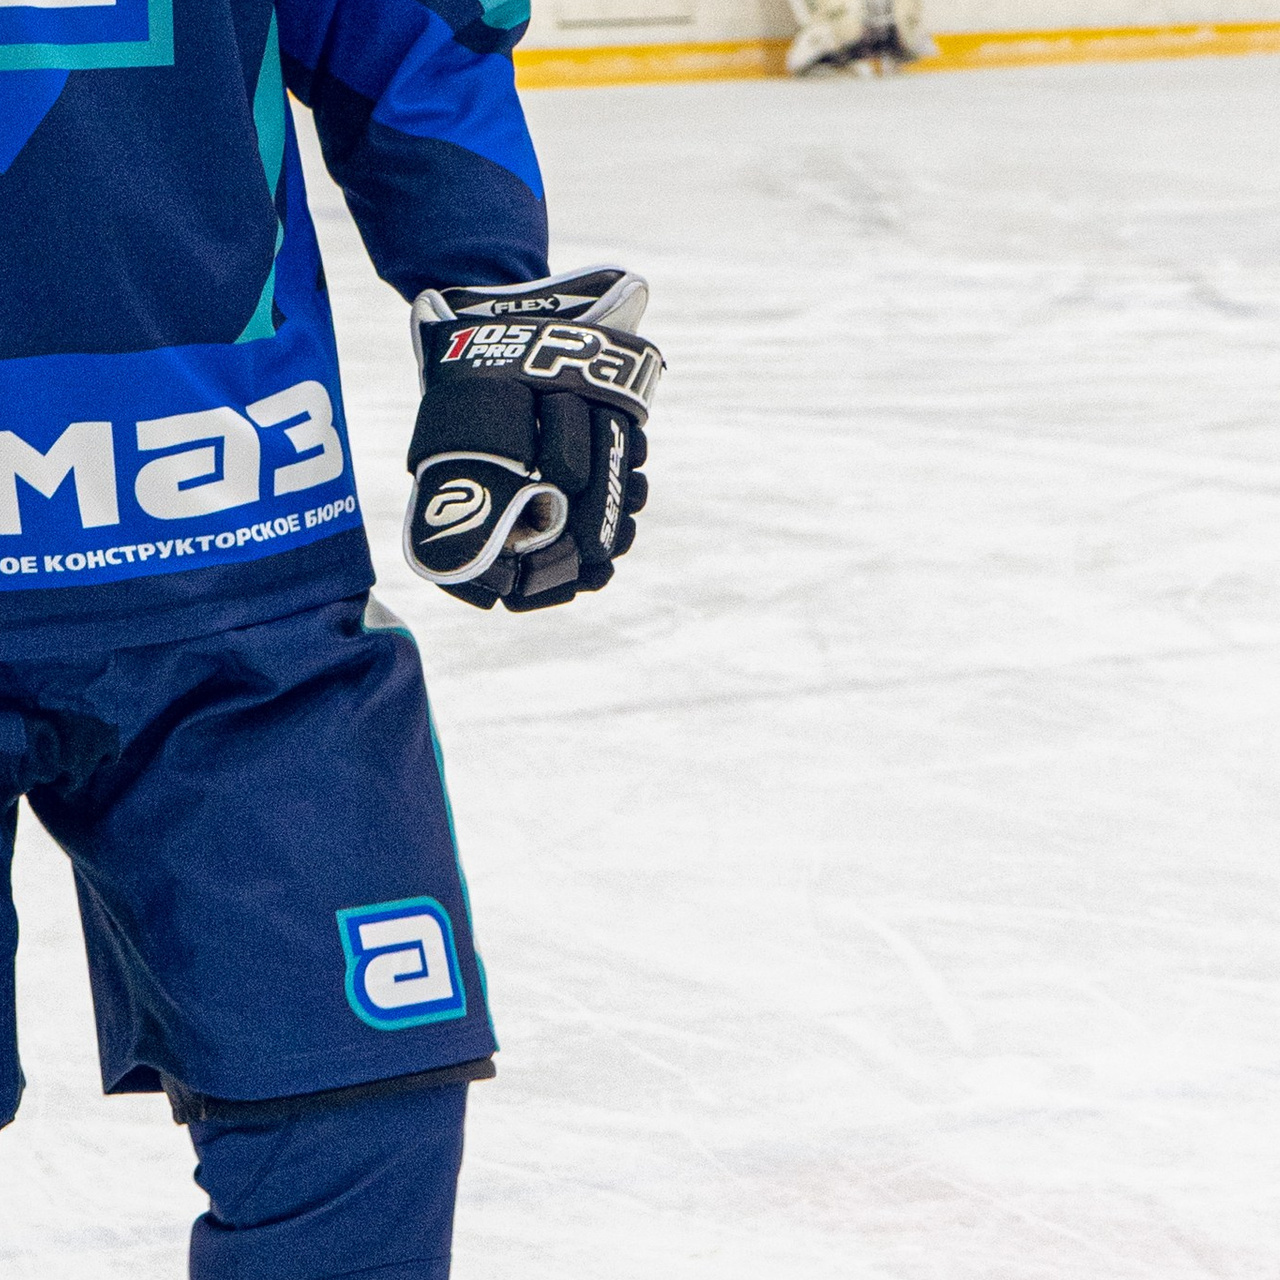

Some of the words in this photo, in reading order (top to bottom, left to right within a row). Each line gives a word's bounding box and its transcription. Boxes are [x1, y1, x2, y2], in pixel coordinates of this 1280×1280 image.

[495, 298, 556, 314] FLEX
[466, 344, 526, 359] PRO
[44, 513, 301, 572] КОНСТРУКТОРСКОЕ
[304, 494, 356, 529] БЮРО
